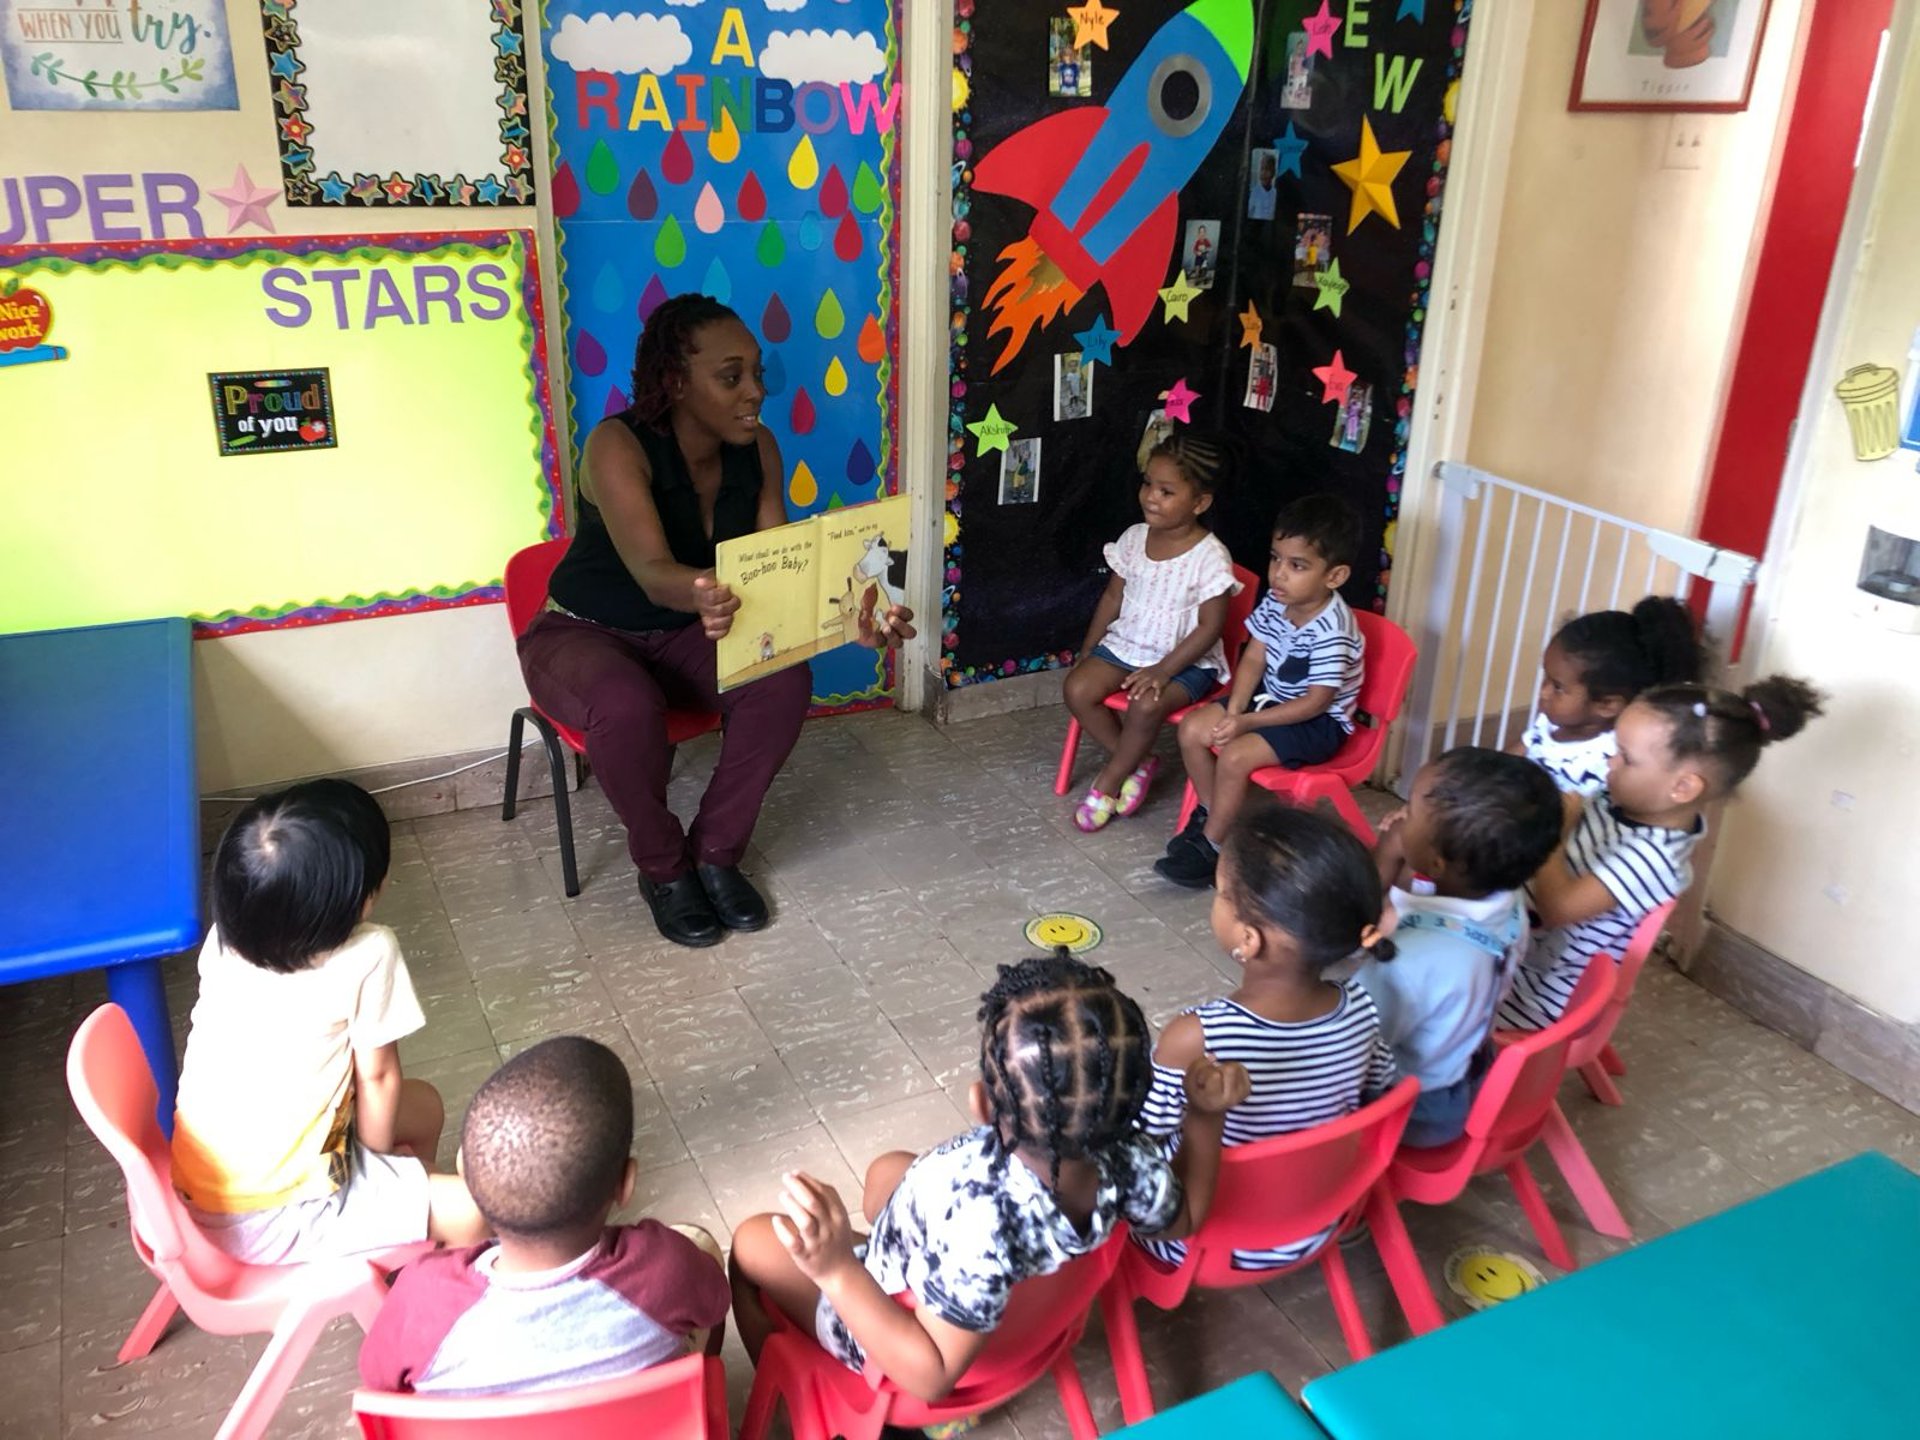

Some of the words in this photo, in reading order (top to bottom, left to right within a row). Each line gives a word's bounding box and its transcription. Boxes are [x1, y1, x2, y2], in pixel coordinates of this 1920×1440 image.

[18, 12, 73, 39] WHEN
[79, 14, 121, 40] YOU
[127, 0, 211, 54] try.
[1080, 10, 1105, 31] Nyle
[711, 8, 755, 67] A
[576, 71, 901, 135] RAINBOW
[0, 301, 40, 321] Nice
[262, 264, 511, 329] STARS
[224, 384, 321, 415] Proud
[238, 416, 256, 432] of
[258, 416, 299, 438] you
[781, 555, 809, 575] Baby?
